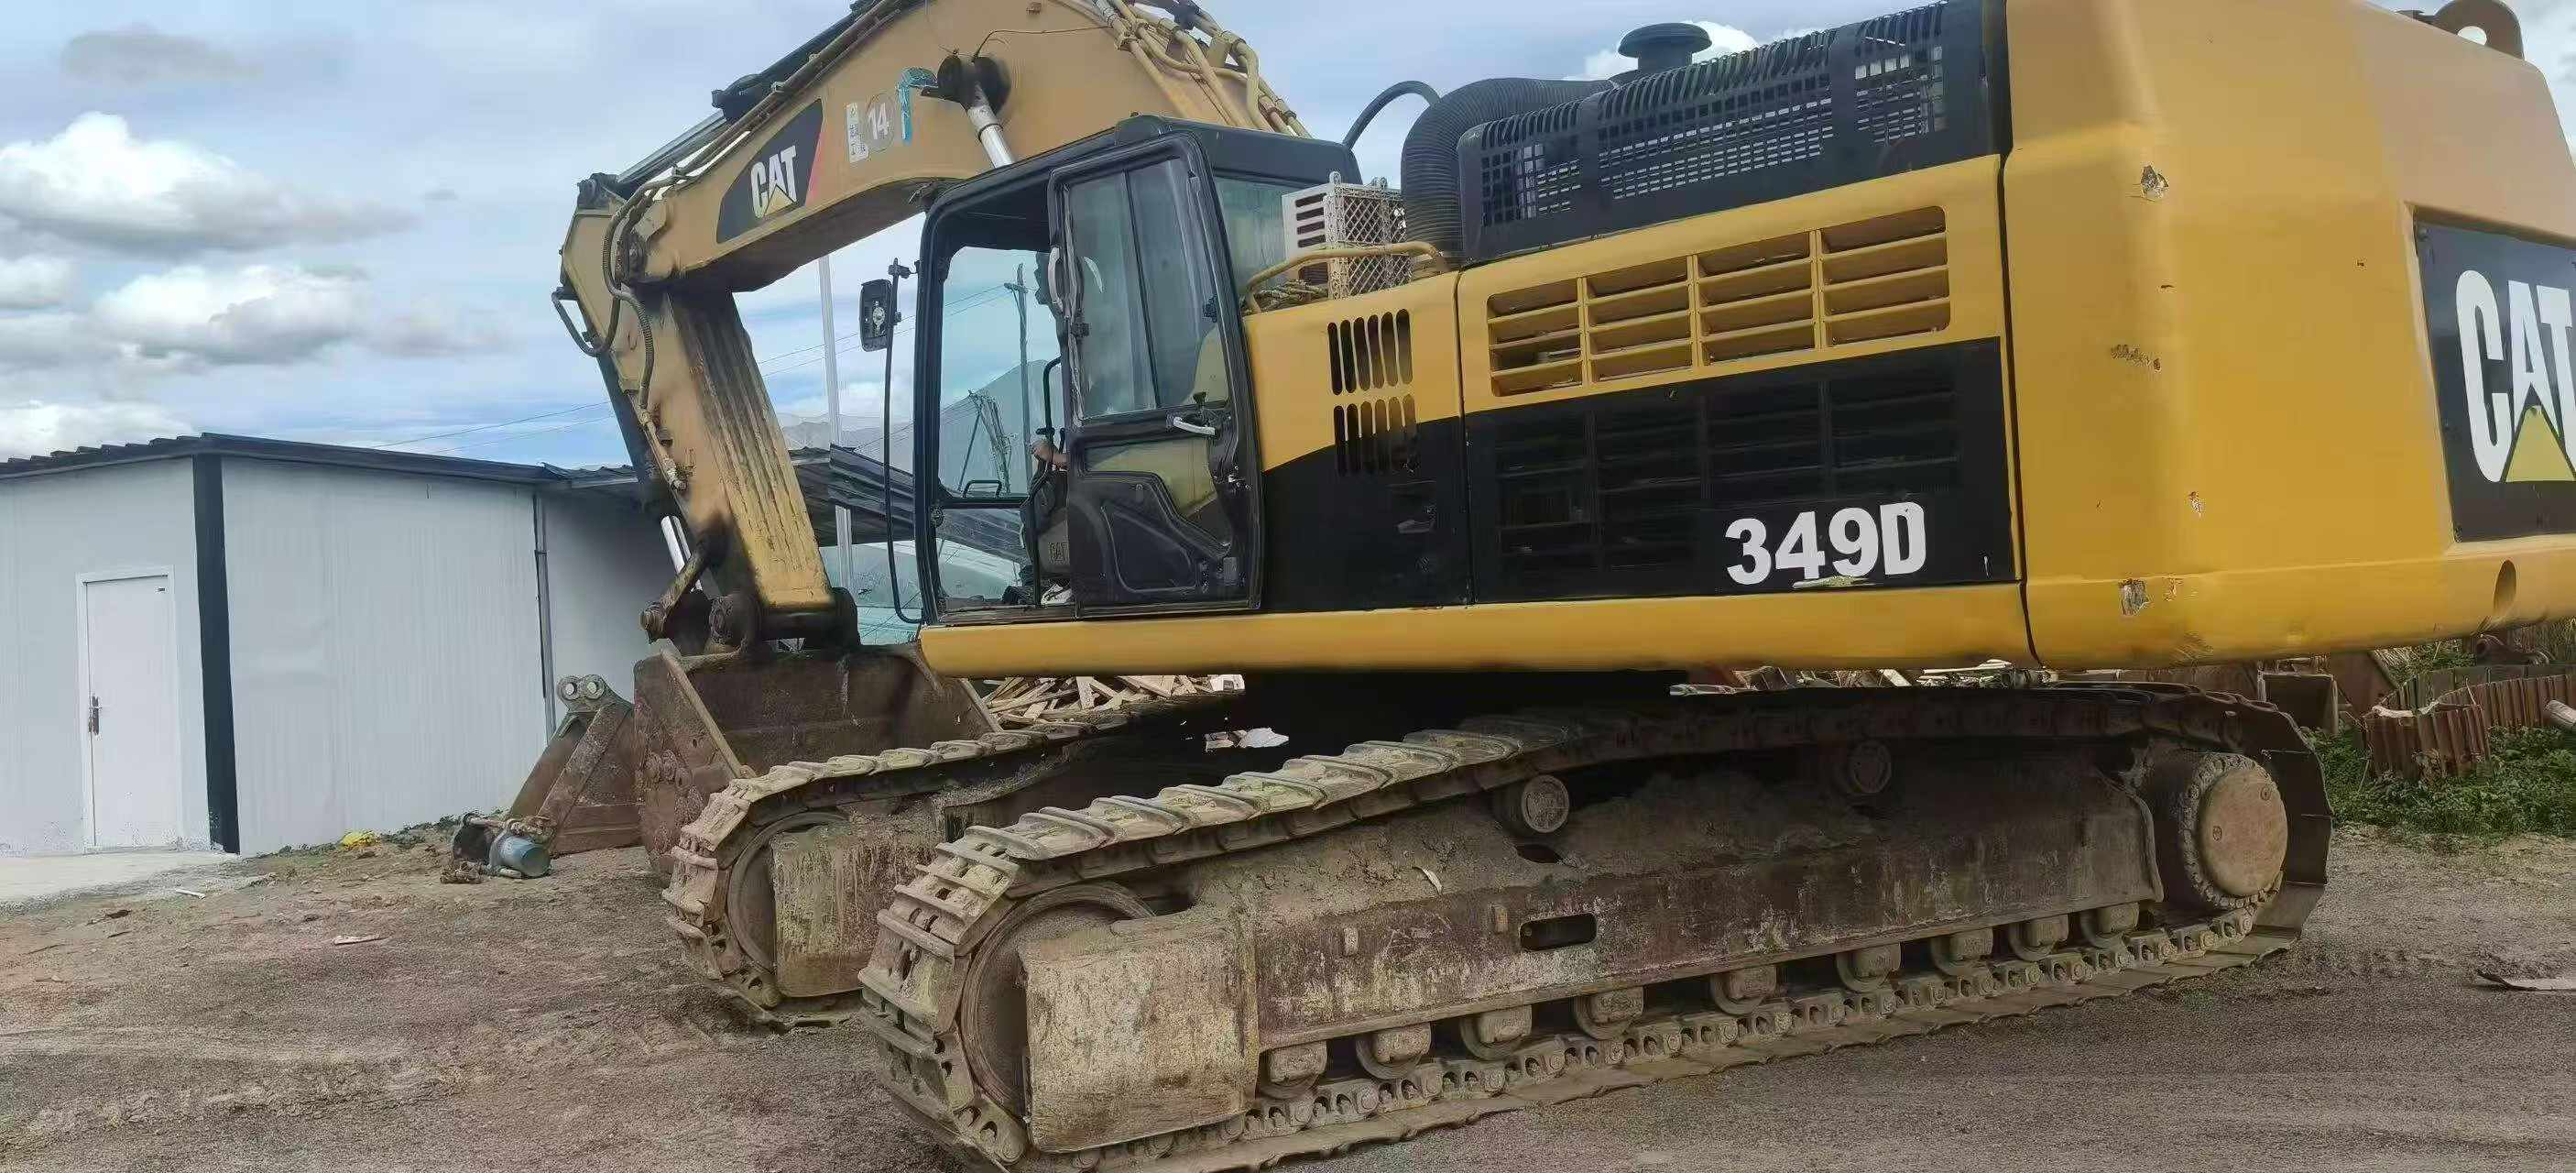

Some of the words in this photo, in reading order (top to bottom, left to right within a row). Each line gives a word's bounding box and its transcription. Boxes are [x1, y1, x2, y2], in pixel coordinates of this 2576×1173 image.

[868, 103, 889, 139] 14
[750, 145, 797, 219] CAT
[2456, 269, 2576, 482] CAT
[1725, 501, 1927, 585] 349D
